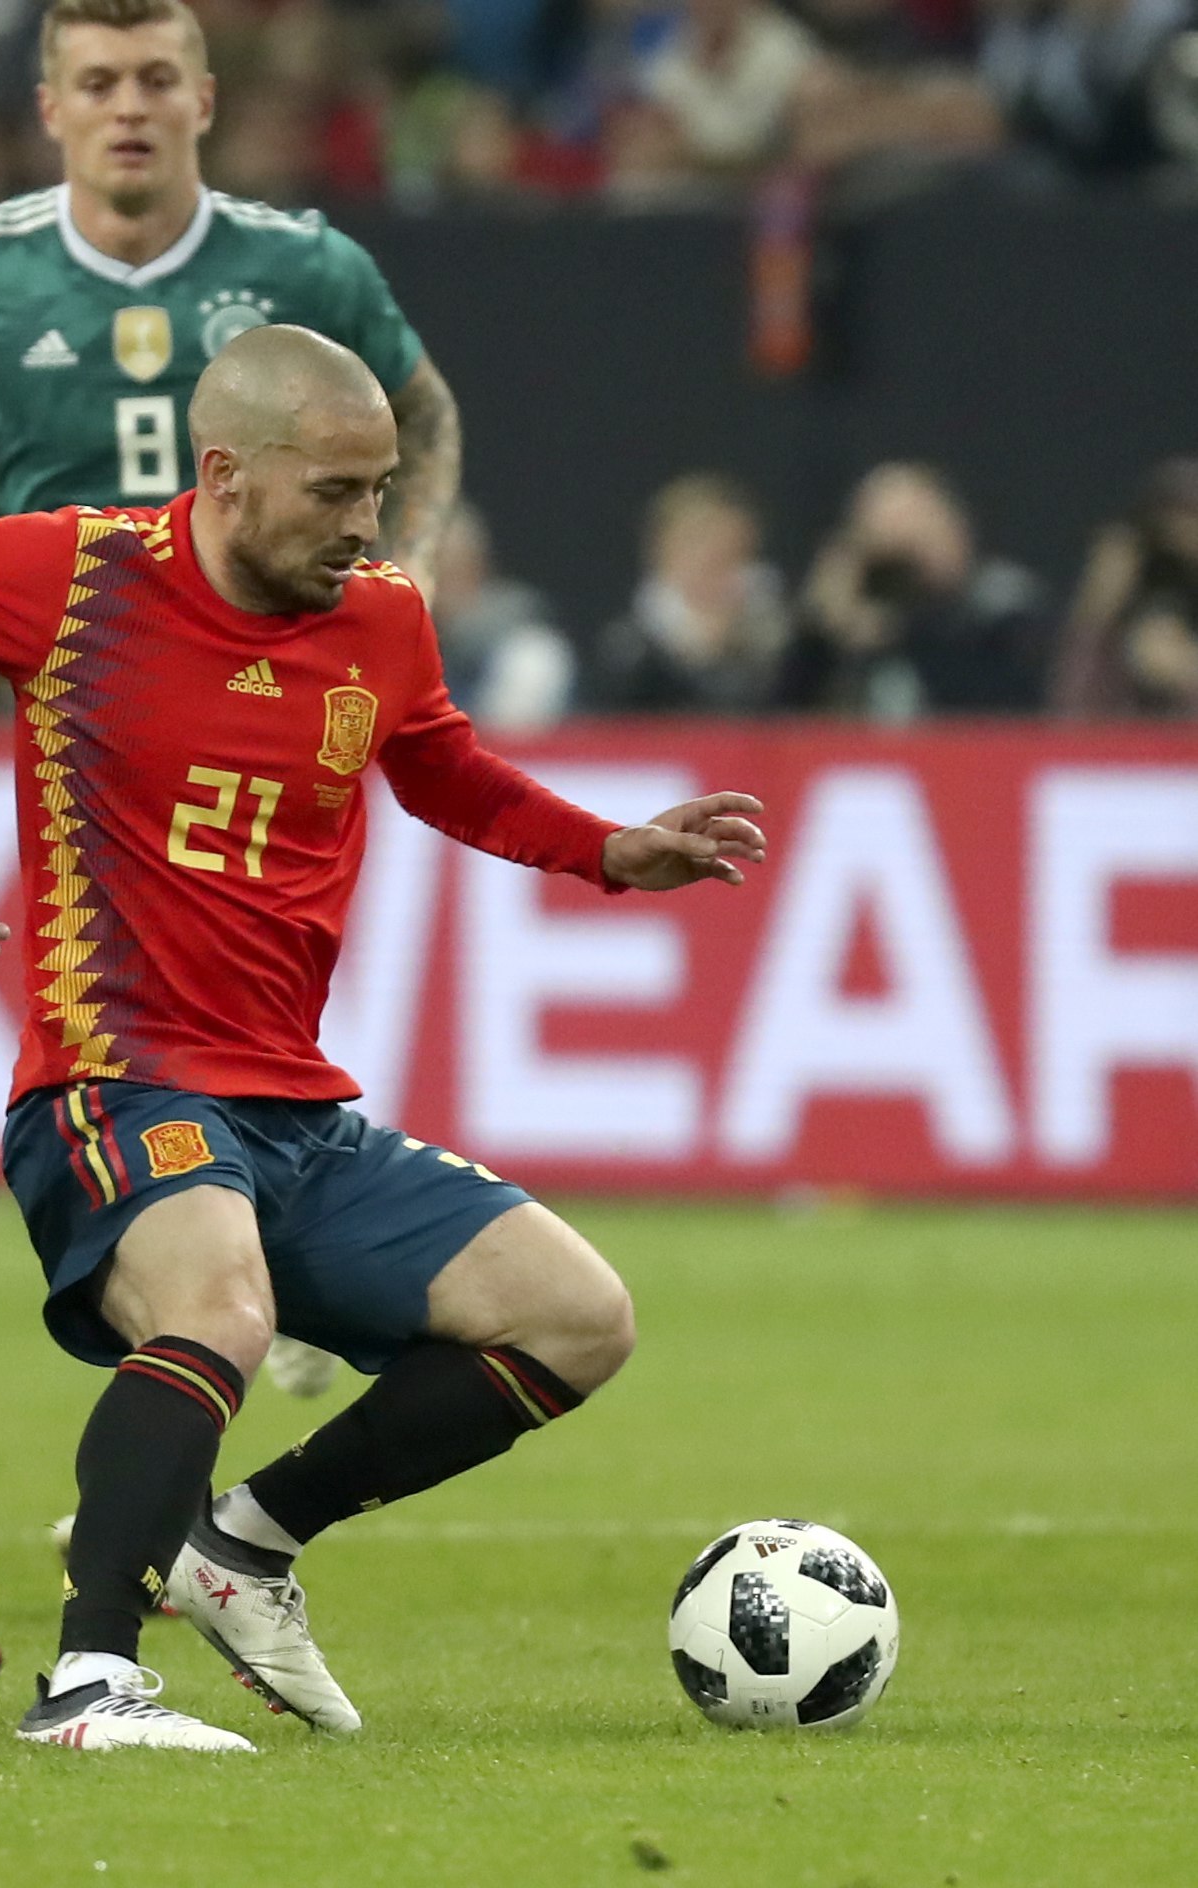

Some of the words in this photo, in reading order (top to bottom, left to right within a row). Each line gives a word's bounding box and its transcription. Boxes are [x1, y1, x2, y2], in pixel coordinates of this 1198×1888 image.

[116, 396, 179, 495] 8
[226, 679, 283, 698] adidas
[168, 765, 284, 878] 21
[747, 1535, 798, 1546] adidas
